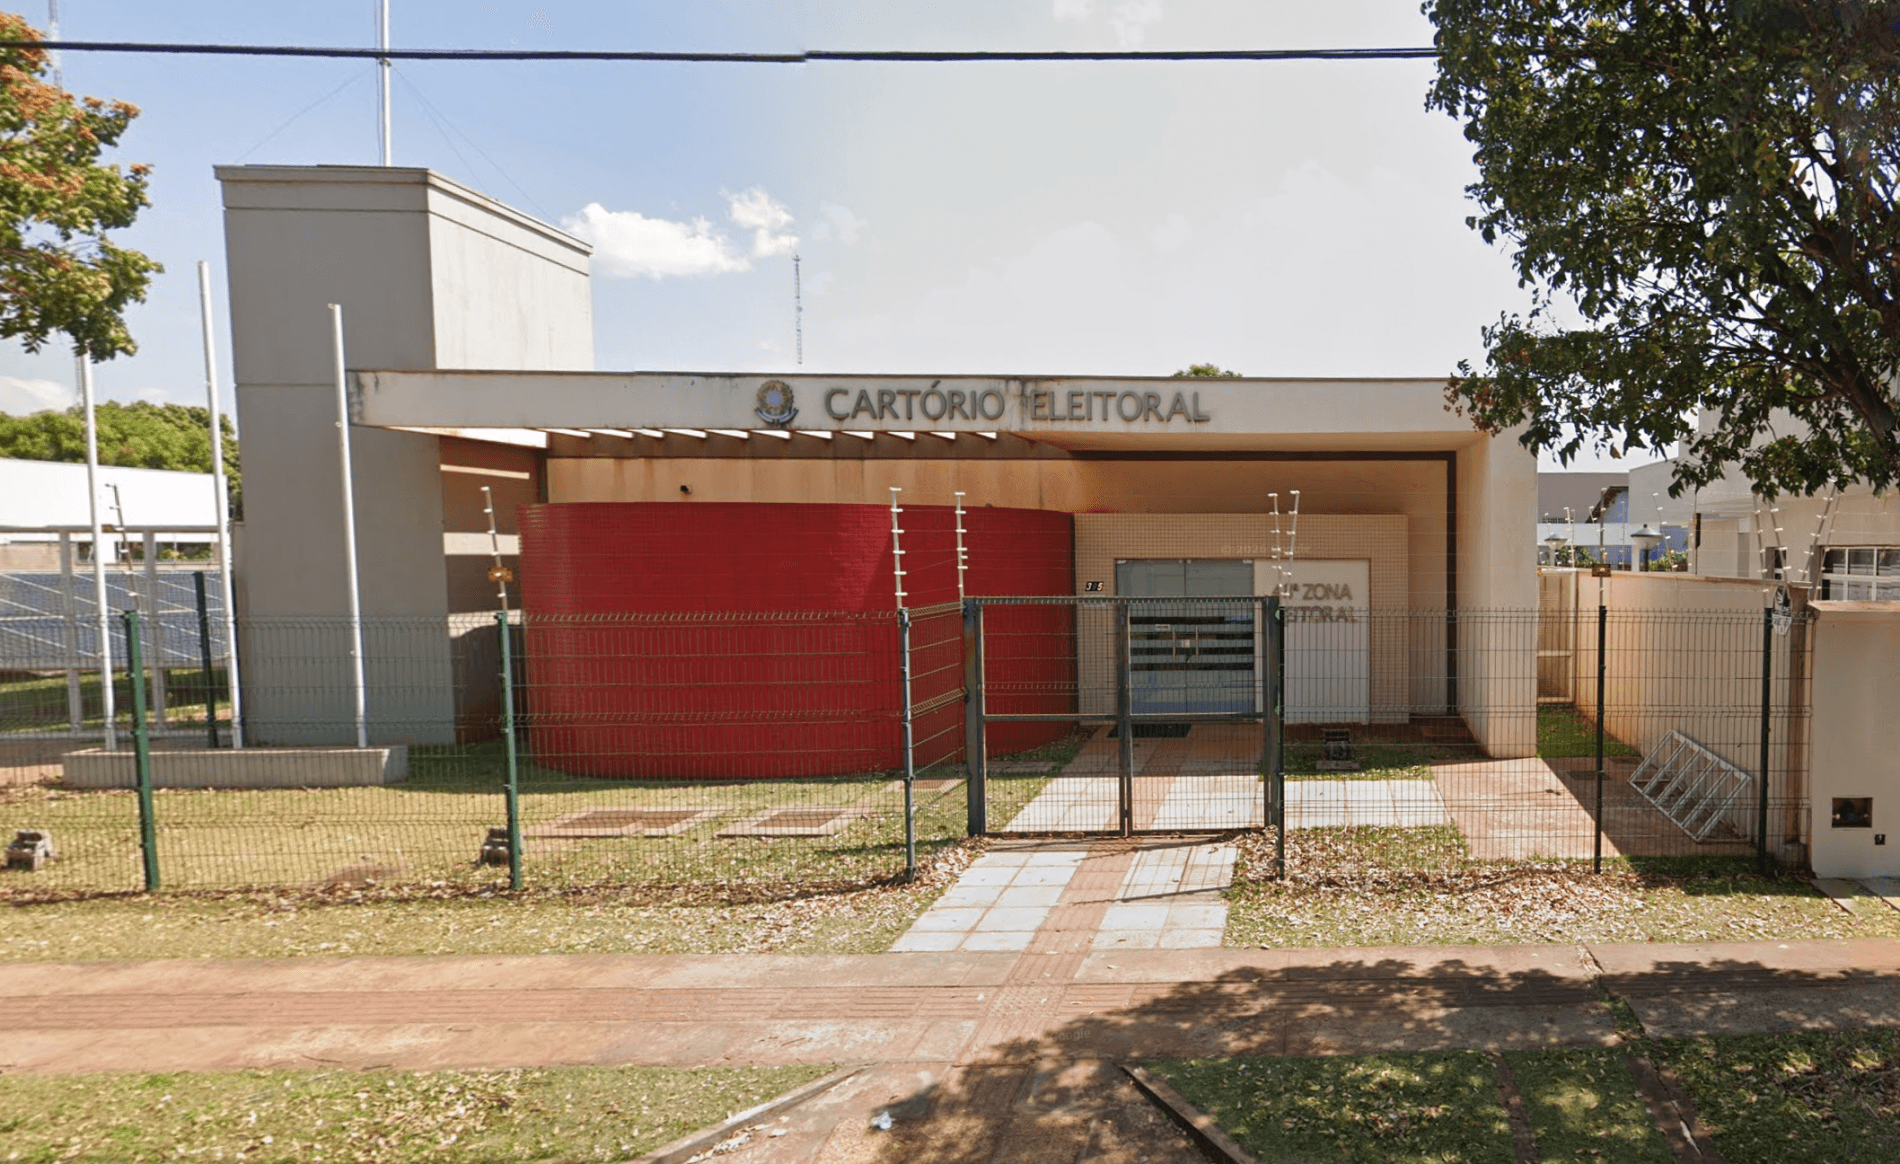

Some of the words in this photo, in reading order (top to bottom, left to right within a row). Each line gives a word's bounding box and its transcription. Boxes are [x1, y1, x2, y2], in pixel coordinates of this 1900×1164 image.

[825, 380, 1004, 421] CARTÓRIO
[1029, 390, 1211, 423] ELEITORAL
[1302, 583, 1353, 600] ZONA
[1284, 606, 1358, 623] EITORAL
